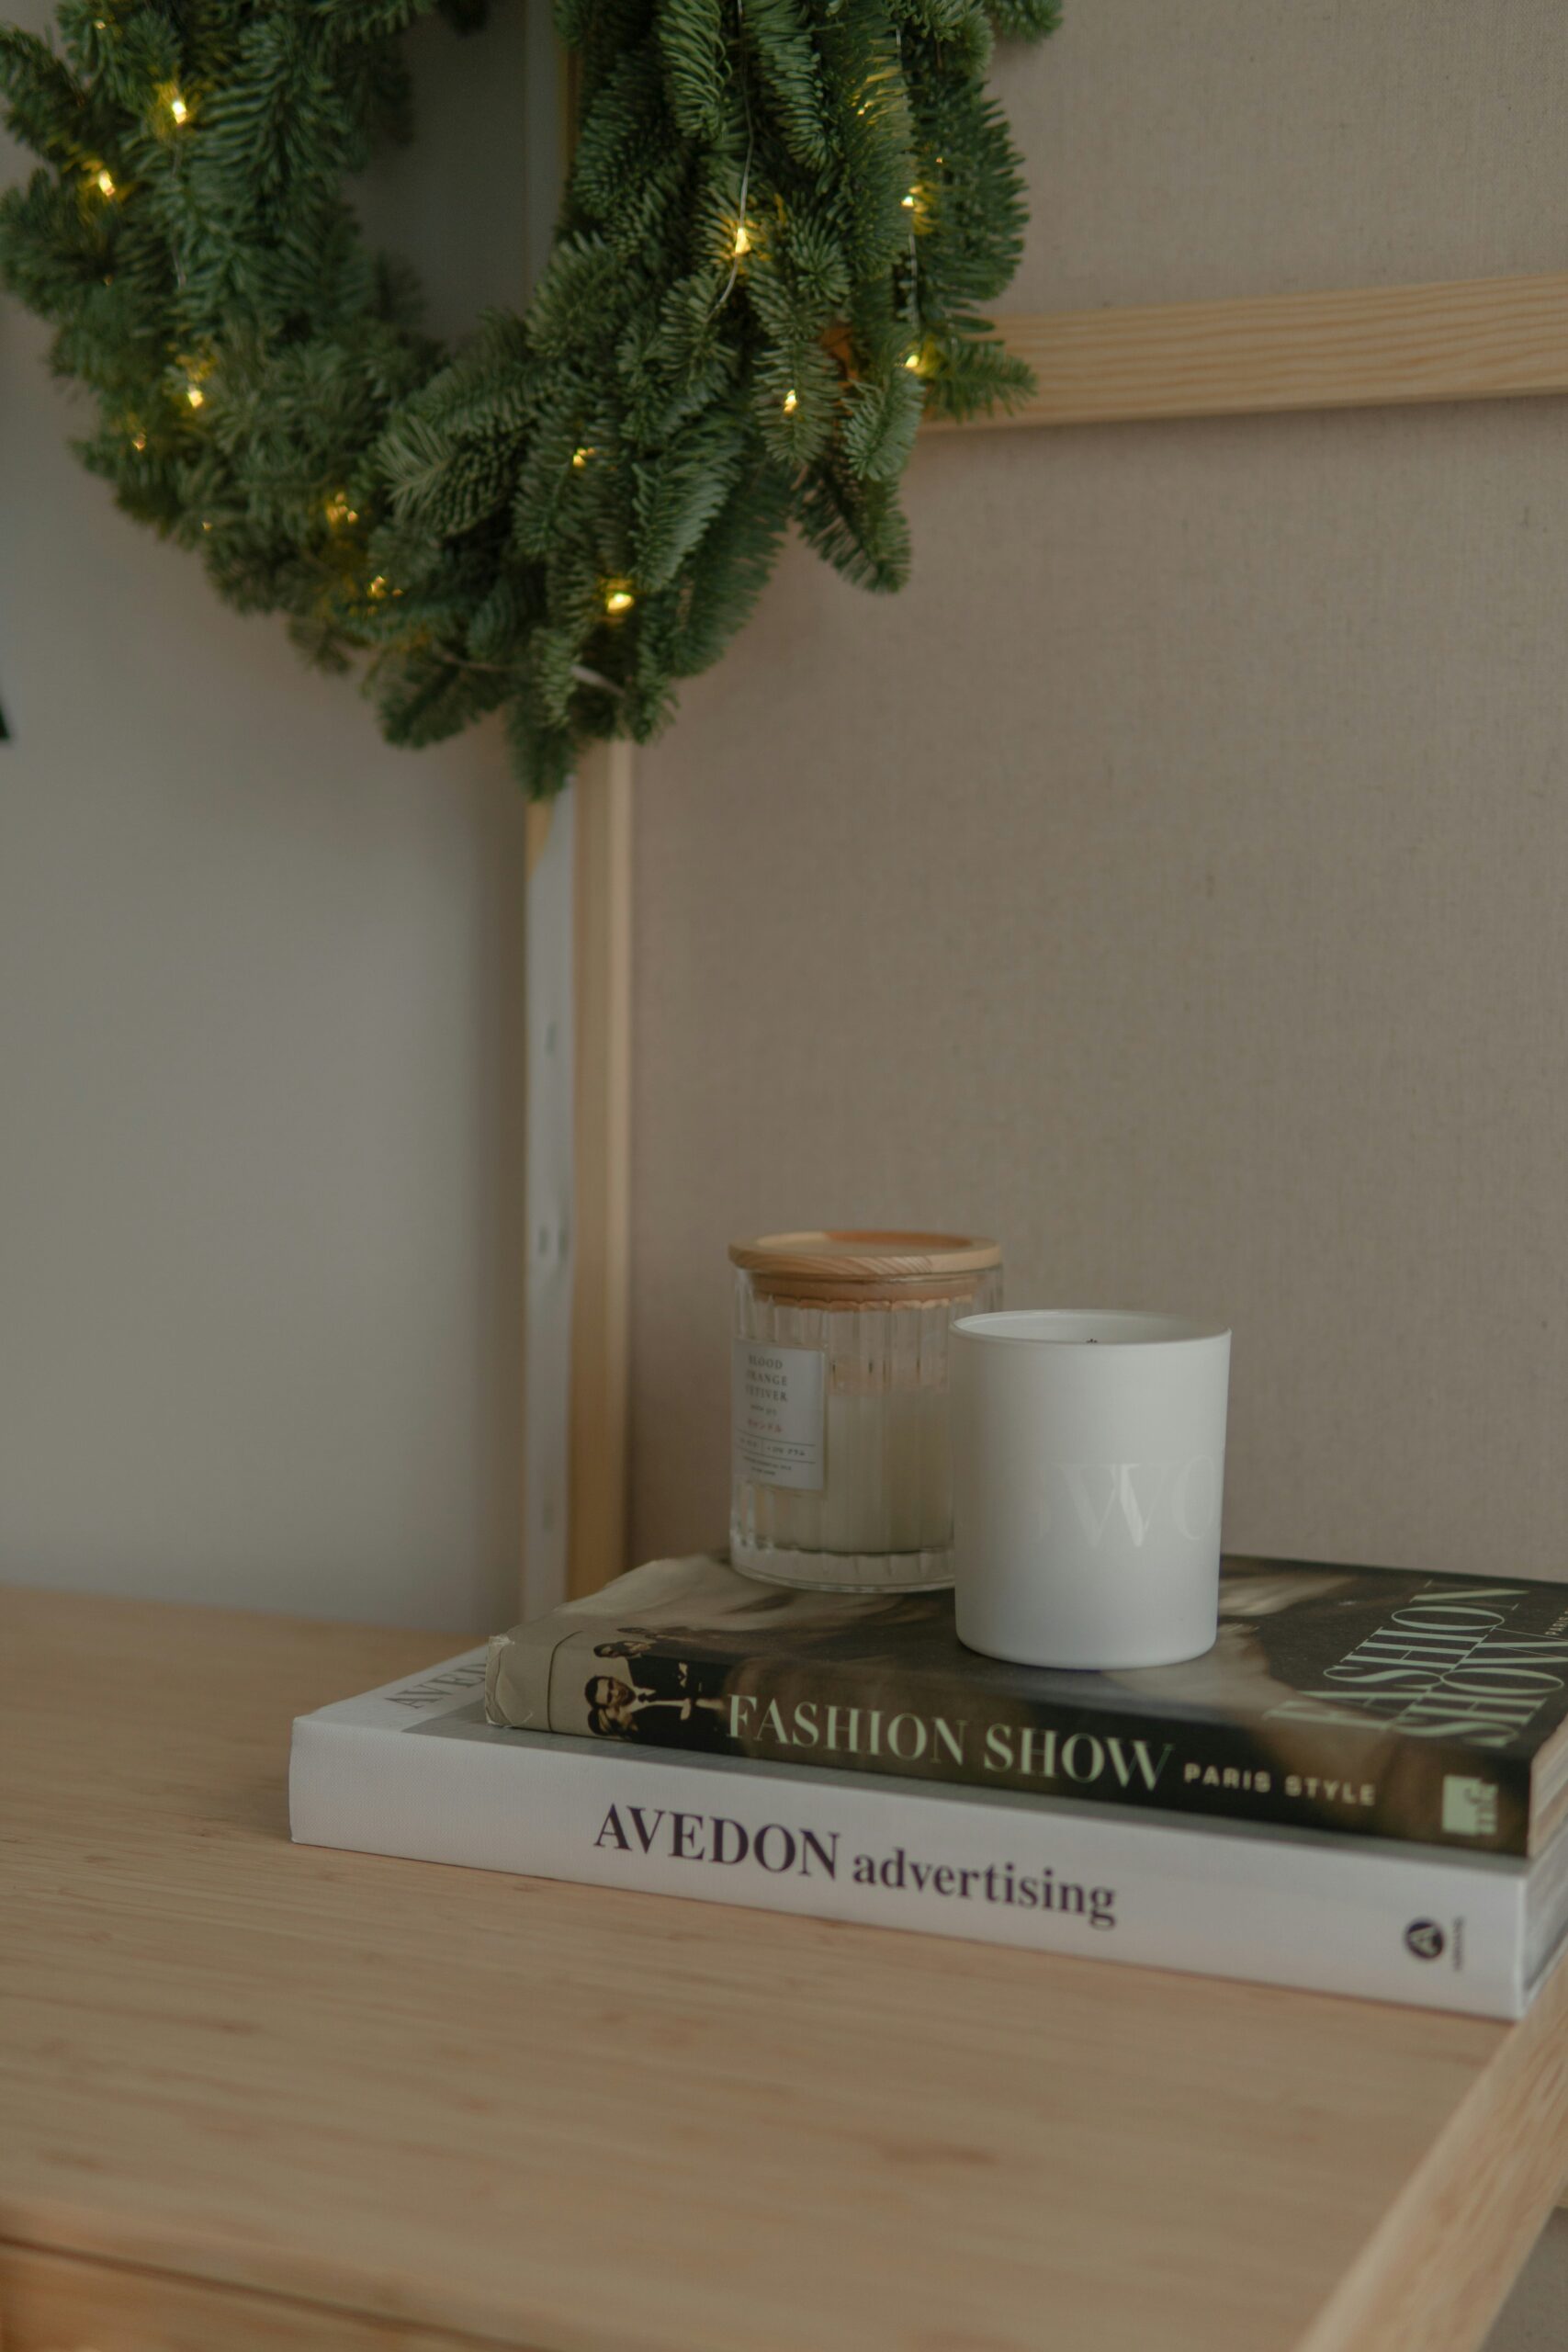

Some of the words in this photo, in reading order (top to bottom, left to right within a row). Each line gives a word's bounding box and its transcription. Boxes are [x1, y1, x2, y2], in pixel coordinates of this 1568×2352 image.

[1261, 1579, 1530, 1732] FASHION
[727, 1693, 968, 1766] FASHION
[984, 1723, 1174, 1791] SHOW
[1184, 1762, 1271, 1792] PARIS
[1285, 1774, 1376, 1806] STYLE
[593, 1803, 840, 1882] AVEDON
[852, 1846, 1116, 1930] advertising
